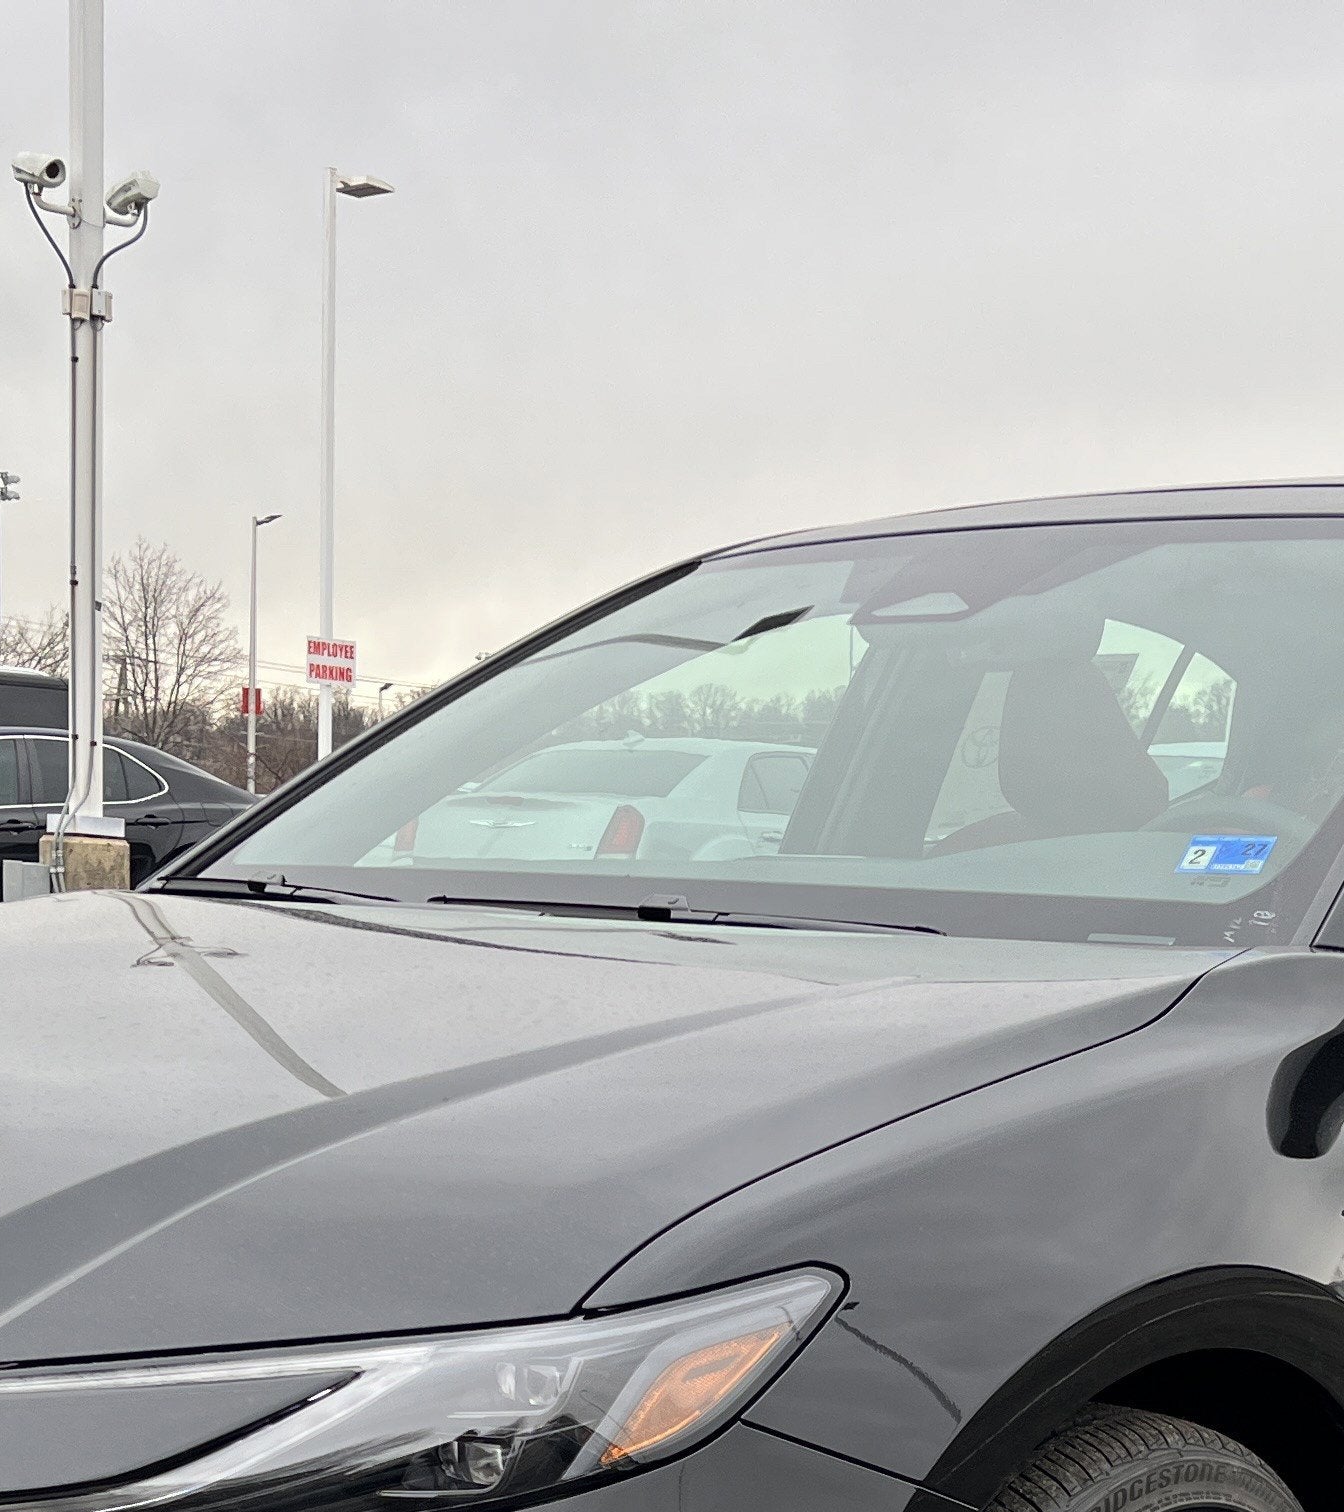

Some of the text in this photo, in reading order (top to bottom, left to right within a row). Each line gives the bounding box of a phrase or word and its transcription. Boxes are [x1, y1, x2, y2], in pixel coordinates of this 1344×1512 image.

[307, 639, 355, 660] EMPLOYEE
[309, 663, 353, 683] PARKING
[1188, 848, 1207, 865] 2
